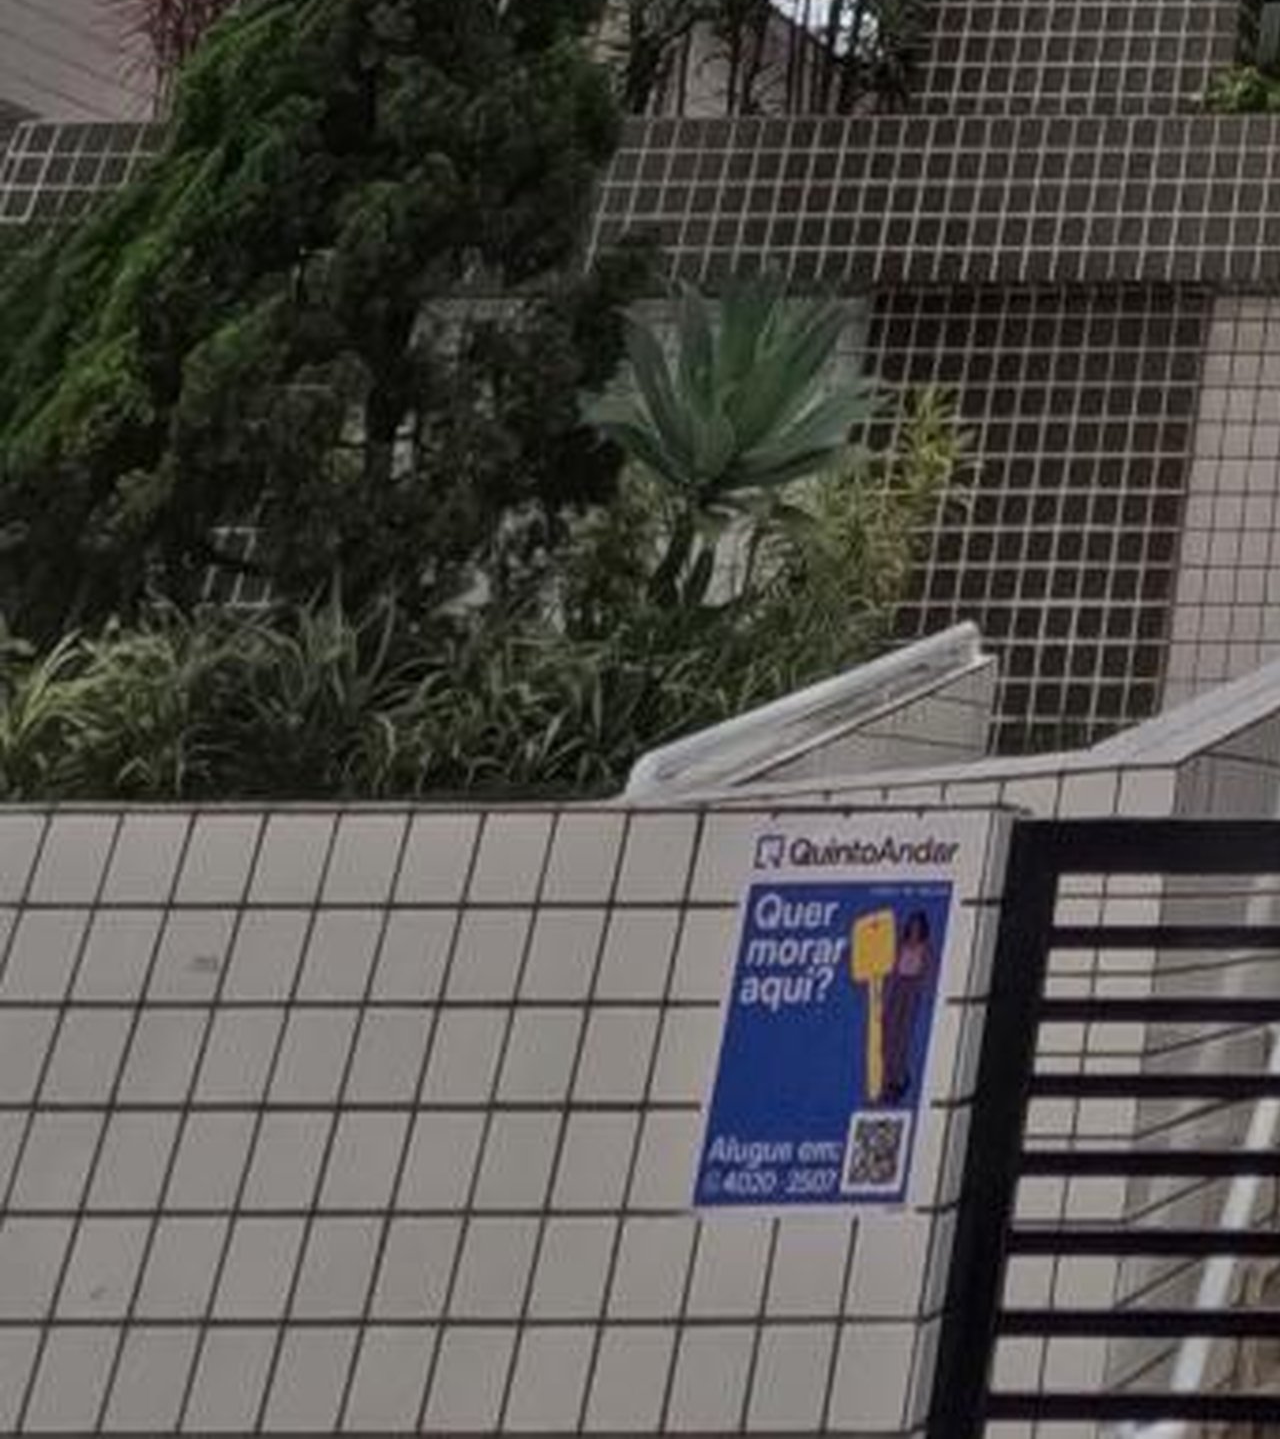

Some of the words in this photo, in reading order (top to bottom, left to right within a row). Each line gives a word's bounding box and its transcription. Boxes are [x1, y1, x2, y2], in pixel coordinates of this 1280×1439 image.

[789, 835, 959, 866] QuintoAndar
[755, 892, 840, 929] Quer
[744, 935, 848, 967] morar
[739, 966, 835, 1012] aqui?
[708, 1135, 793, 1169] Alugue
[721, 1168, 778, 1195] 4020
